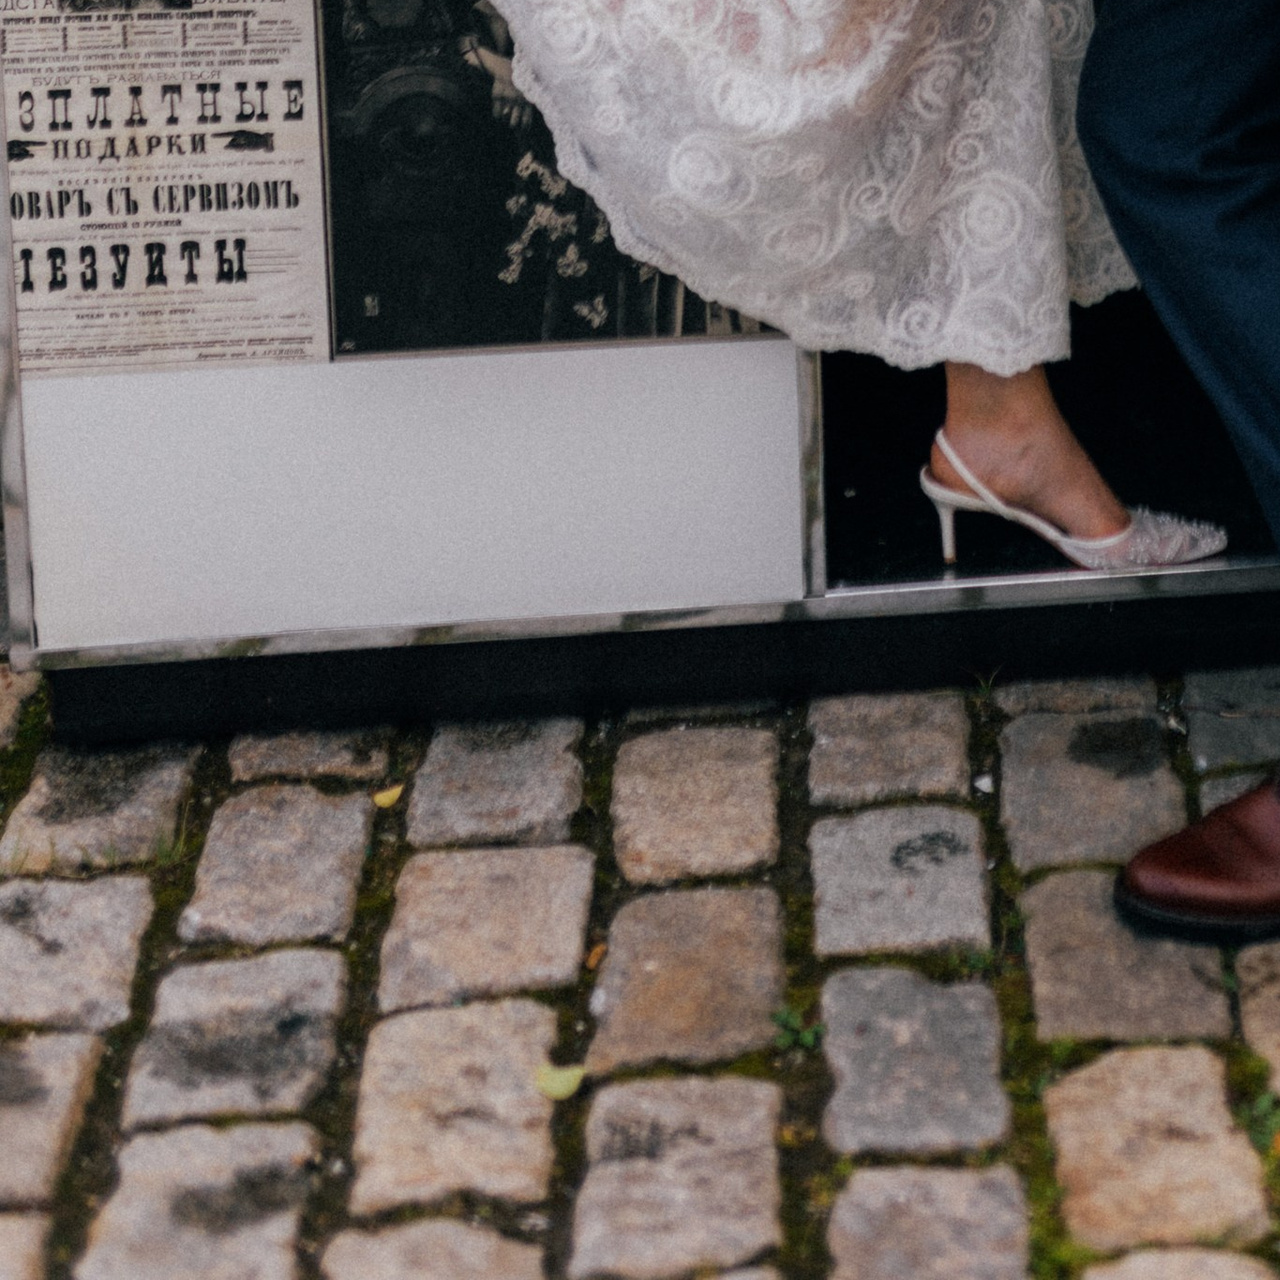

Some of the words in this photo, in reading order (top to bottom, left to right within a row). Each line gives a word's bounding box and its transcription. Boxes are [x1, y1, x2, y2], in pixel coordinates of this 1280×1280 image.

[18, 79, 305, 133] ЗПЛАТНЫЕ
[51, 133, 208, 164] ПОДАРКИ
[106, 187, 140, 217] СЪ
[152, 180, 300, 216] СЕРВИЗОМЪ
[19, 238, 249, 294] ІЕЗУИТЫ
